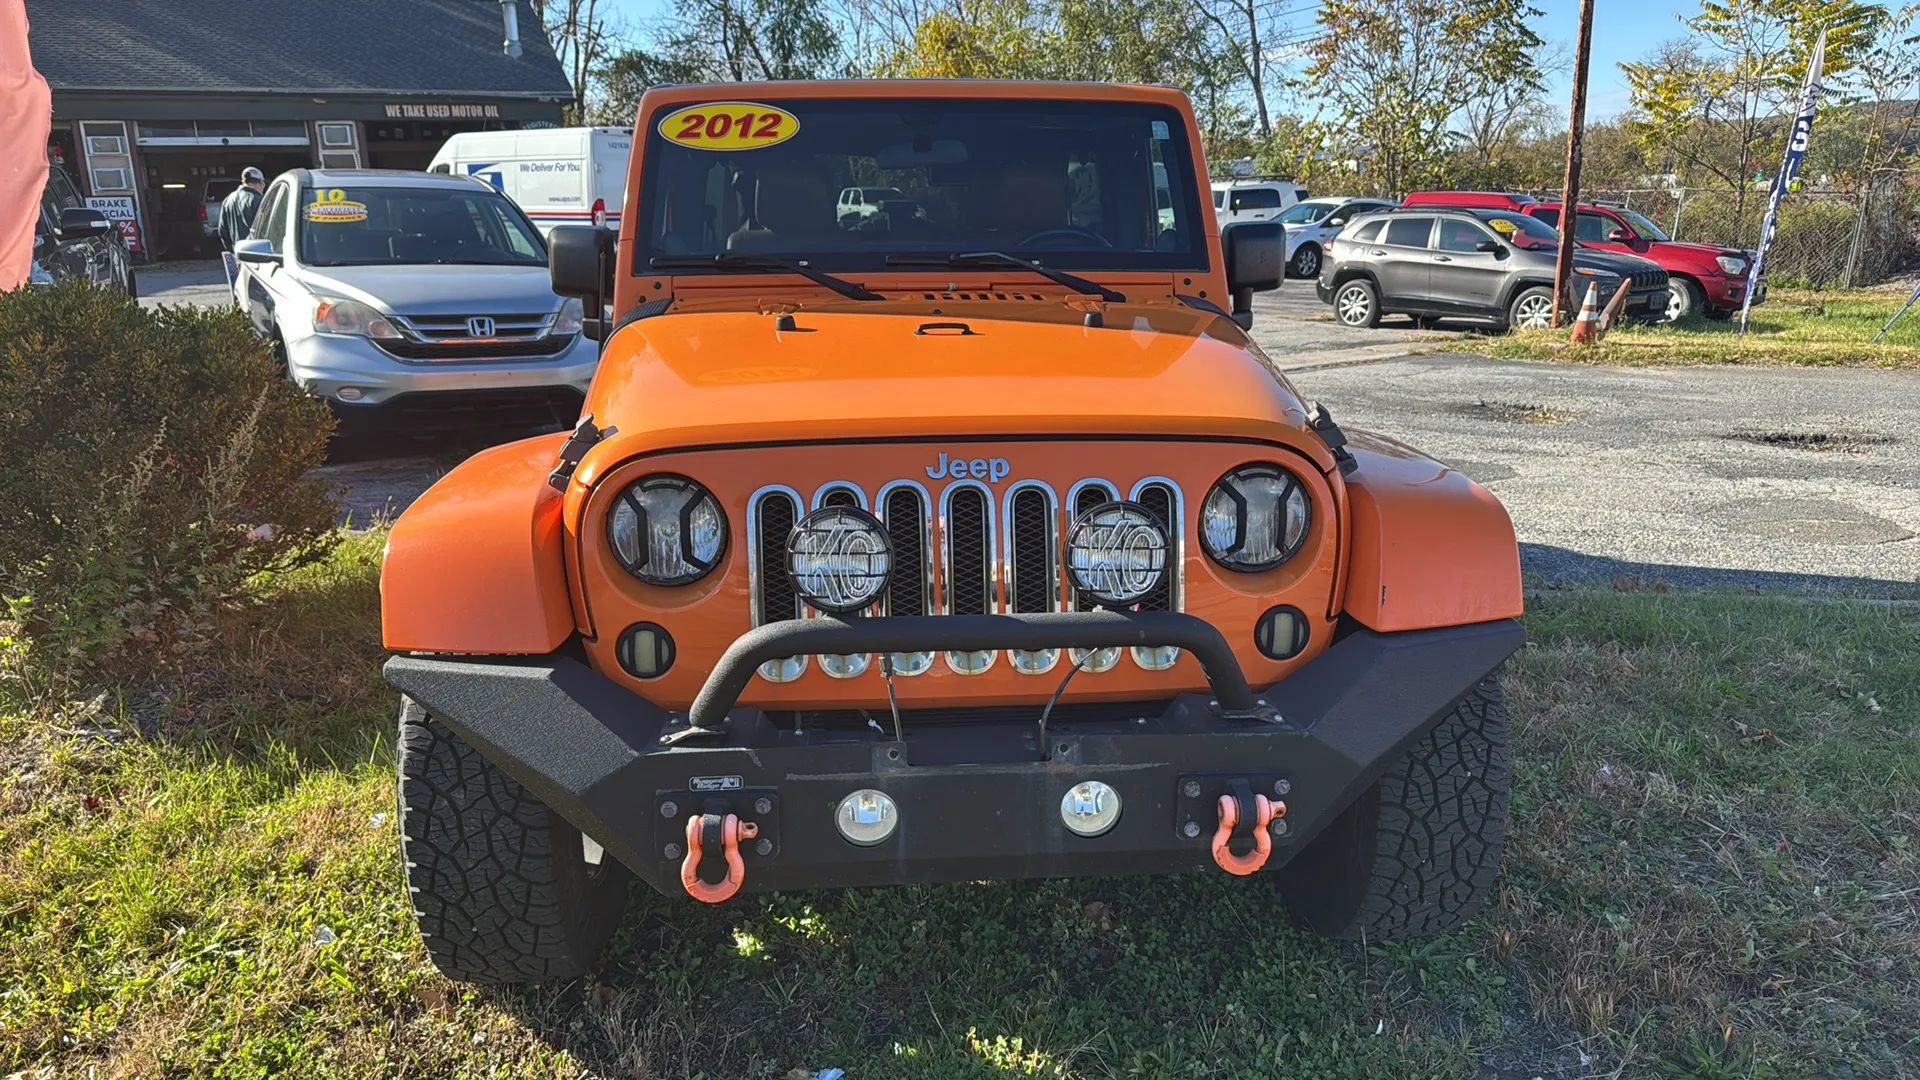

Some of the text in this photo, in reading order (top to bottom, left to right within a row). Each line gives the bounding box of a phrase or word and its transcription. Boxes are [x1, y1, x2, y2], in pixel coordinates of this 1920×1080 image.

[385, 105, 499, 118] WE TAKE USED MOTOR OIL
[675, 113, 783, 139] 2012
[520, 163, 530, 172] We
[531, 162, 554, 172] Deliver
[554, 162, 566, 172] For
[91, 199, 127, 207] BRAKE
[926, 452, 1010, 483] Jeep
[804, 524, 879, 605] KC
[1088, 519, 1160, 600] KC
